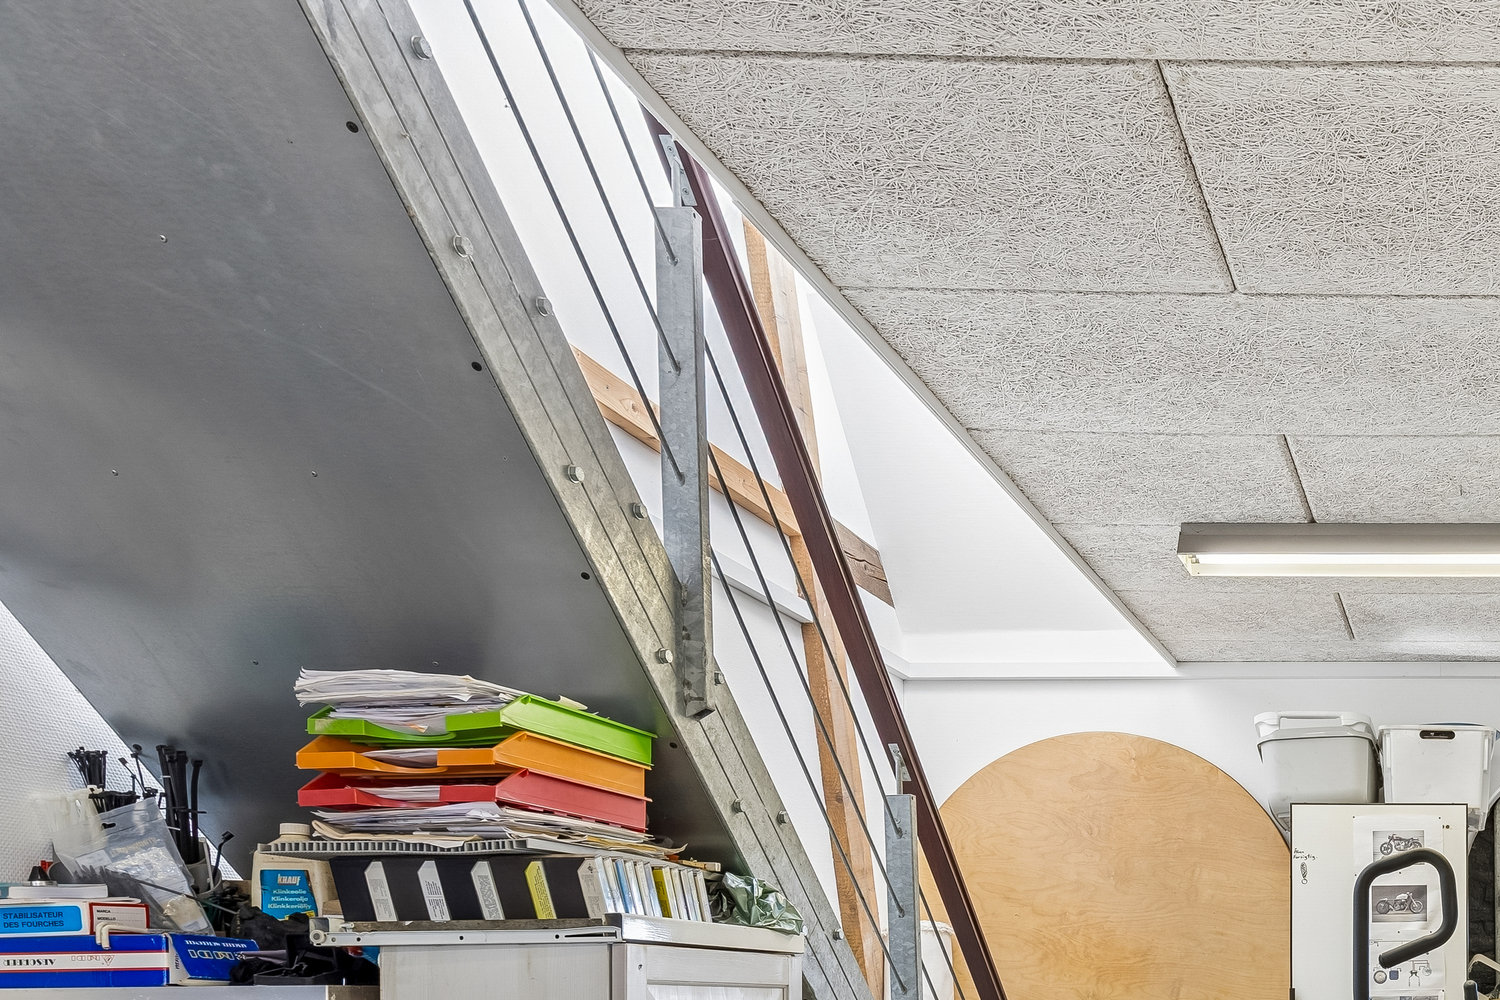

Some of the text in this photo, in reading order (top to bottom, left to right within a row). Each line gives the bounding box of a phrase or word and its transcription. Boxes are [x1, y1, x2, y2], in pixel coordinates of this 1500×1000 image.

[277, 873, 301, 886] KNAUF
[3, 911, 64, 920] STABILISATEUR
[3, 919, 65, 928] DES FOURCHES
